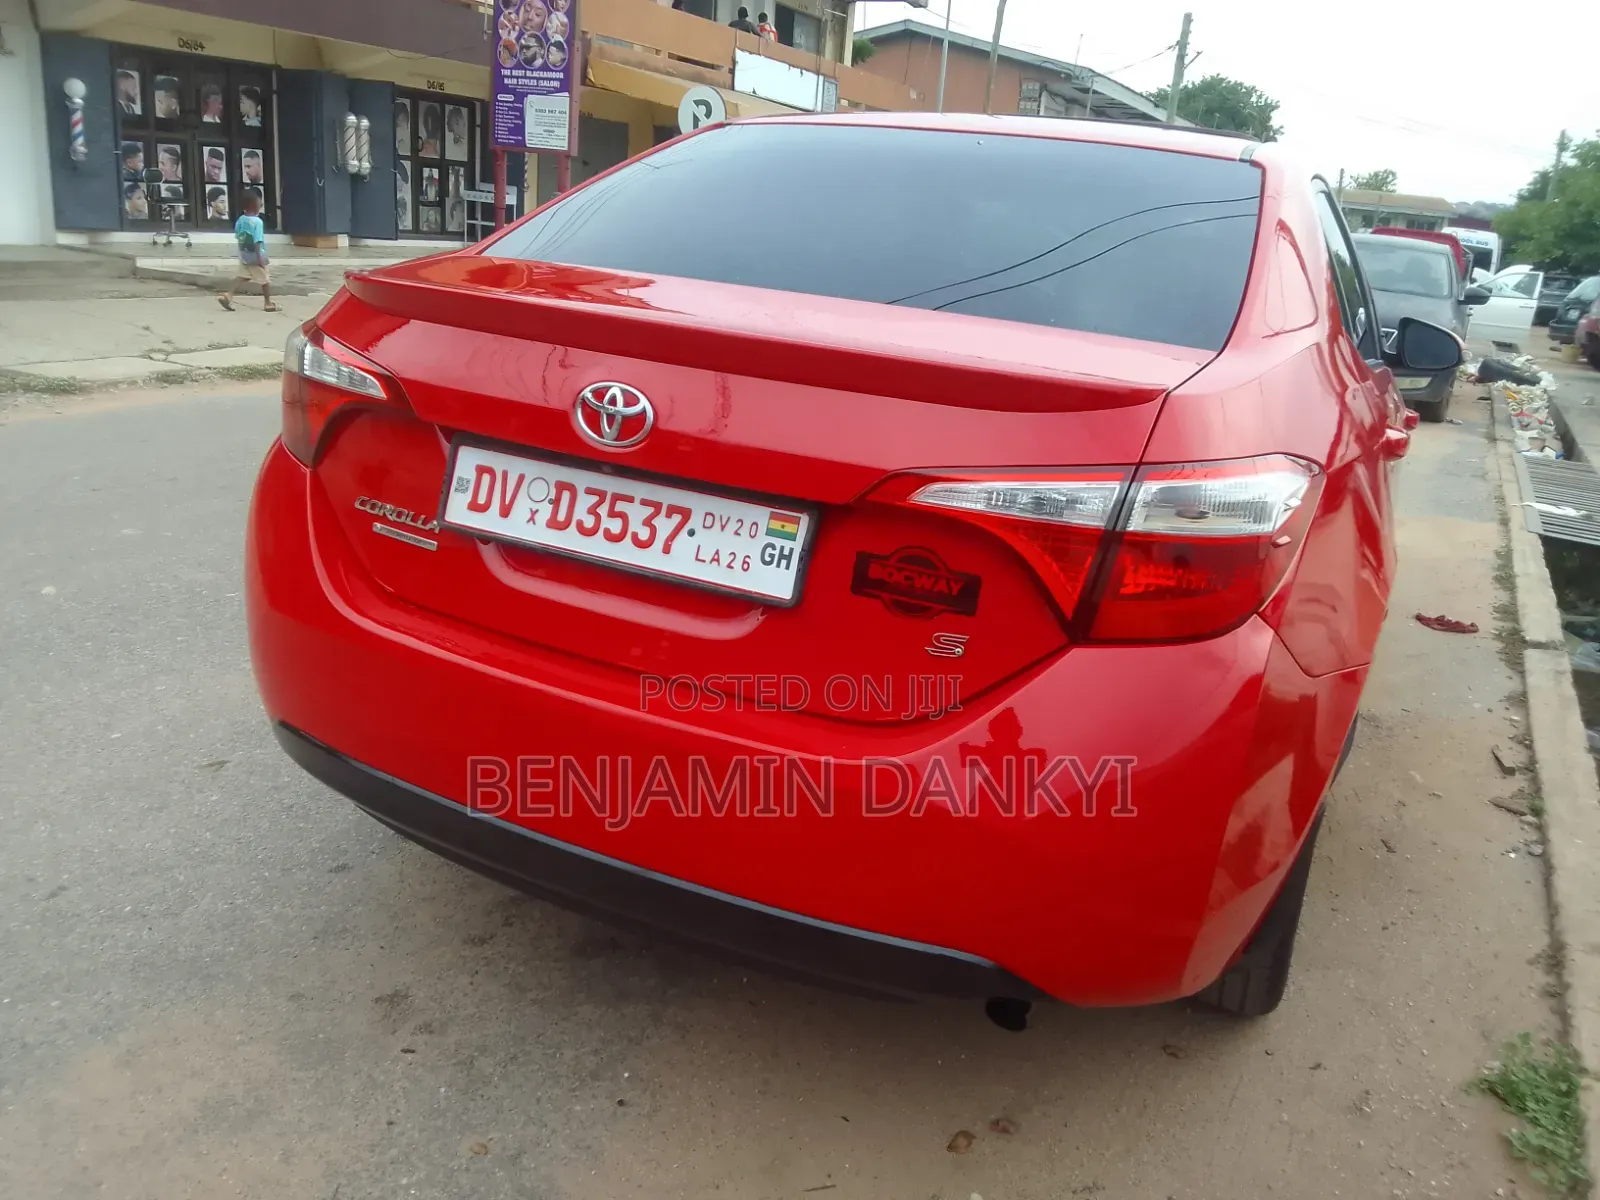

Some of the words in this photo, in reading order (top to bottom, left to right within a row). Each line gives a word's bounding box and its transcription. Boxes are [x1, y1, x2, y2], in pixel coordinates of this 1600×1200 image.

[504, 77, 517, 85] HAIR
[518, 78, 537, 86] STYLES
[538, 79, 560, 89] (SALON)
[354, 495, 440, 534] COROLLA
[466, 463, 526, 519] DV
[545, 479, 693, 555] D3537
[702, 511, 759, 539] DV20
[694, 544, 752, 572] LA26
[760, 541, 795, 571] GH
[924, 632, 970, 658] S
